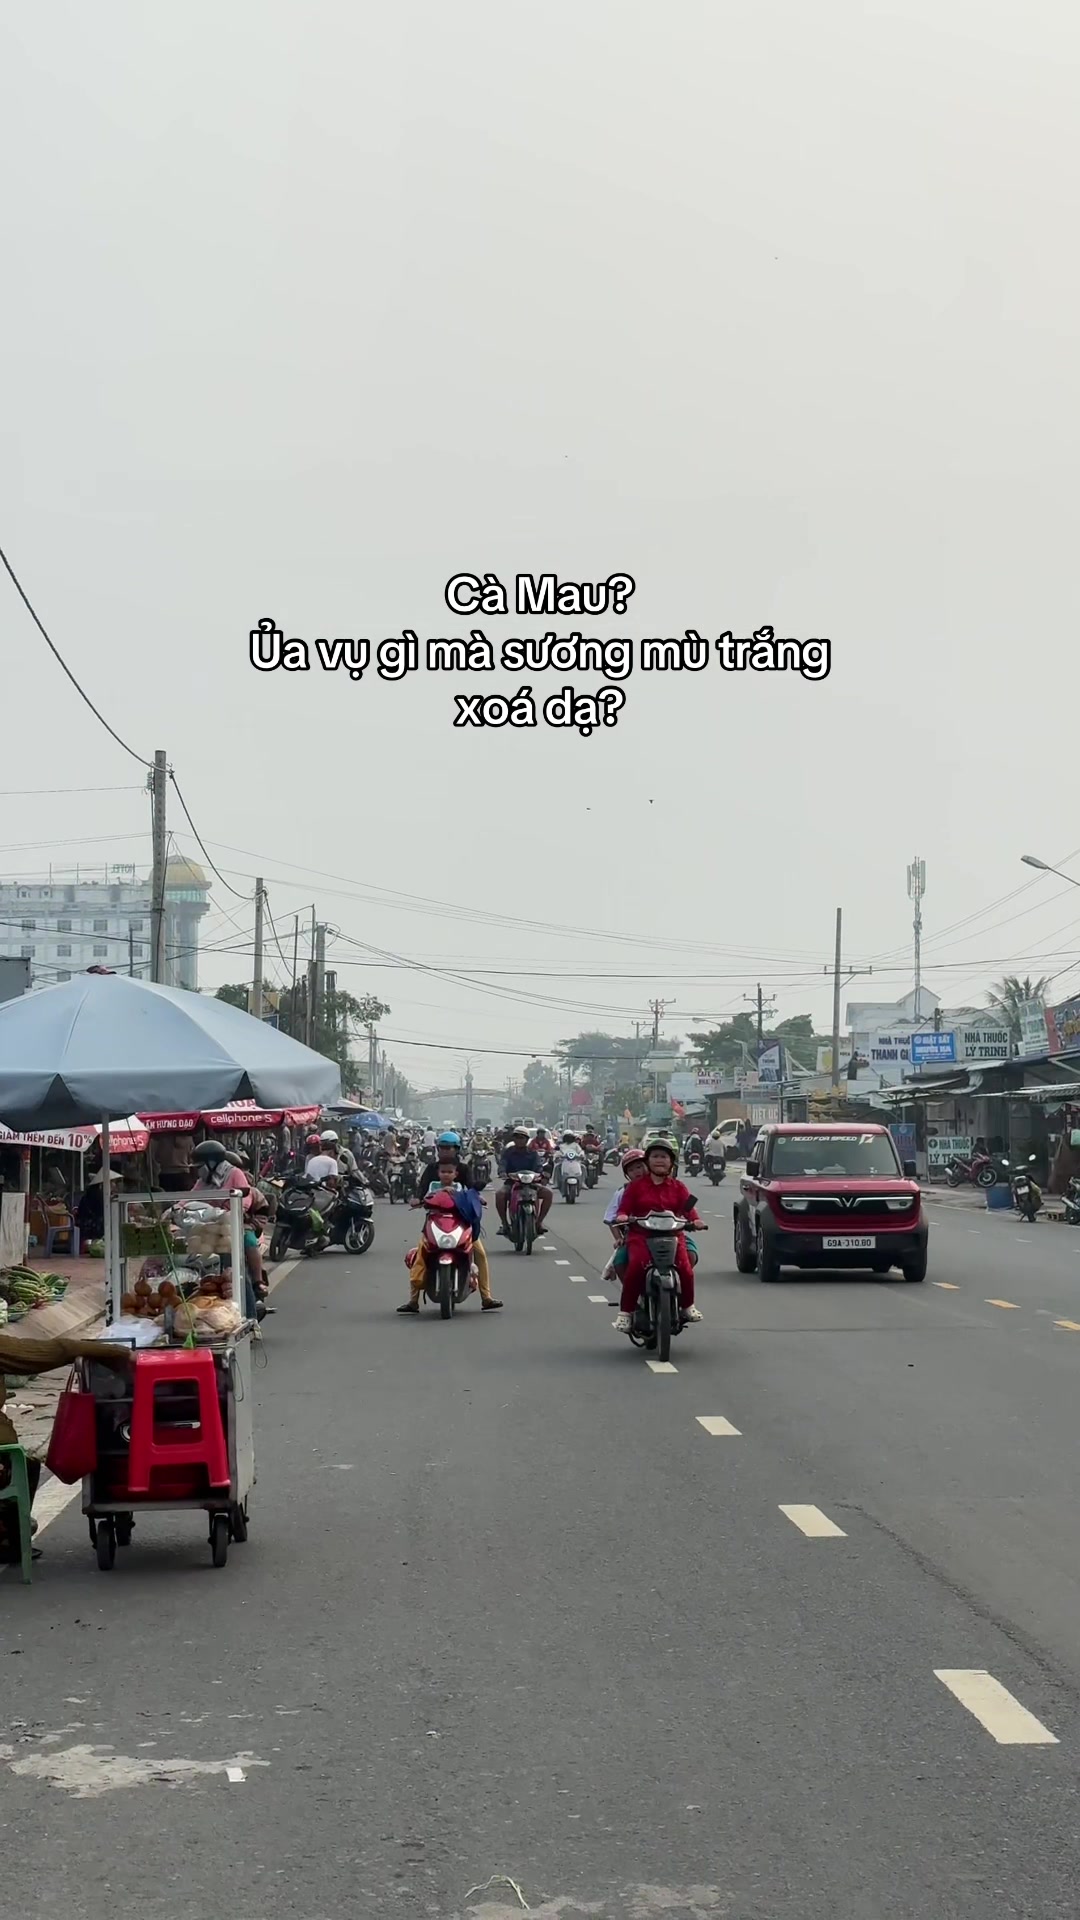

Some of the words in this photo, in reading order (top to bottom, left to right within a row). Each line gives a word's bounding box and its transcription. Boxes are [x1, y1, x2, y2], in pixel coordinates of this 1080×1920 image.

[879, 1036, 892, 1045] NHÀ
[894, 1036, 910, 1045] THUỐ
[964, 1030, 981, 1043] NHÀ
[983, 1030, 1008, 1043] THUỐC
[871, 1049, 898, 1060] THANH
[965, 1043, 977, 1057] LÝ
[978, 1046, 1008, 1057] TRINH
[156, 1119, 177, 1129] HƯNG
[178, 1118, 194, 1128] ĐẠO
[22, 1130, 46, 1143] THÊM
[47, 1133, 65, 1145] ĐẾN
[68, 1133, 93, 1148] 10%
[929, 1150, 940, 1163] LÝ
